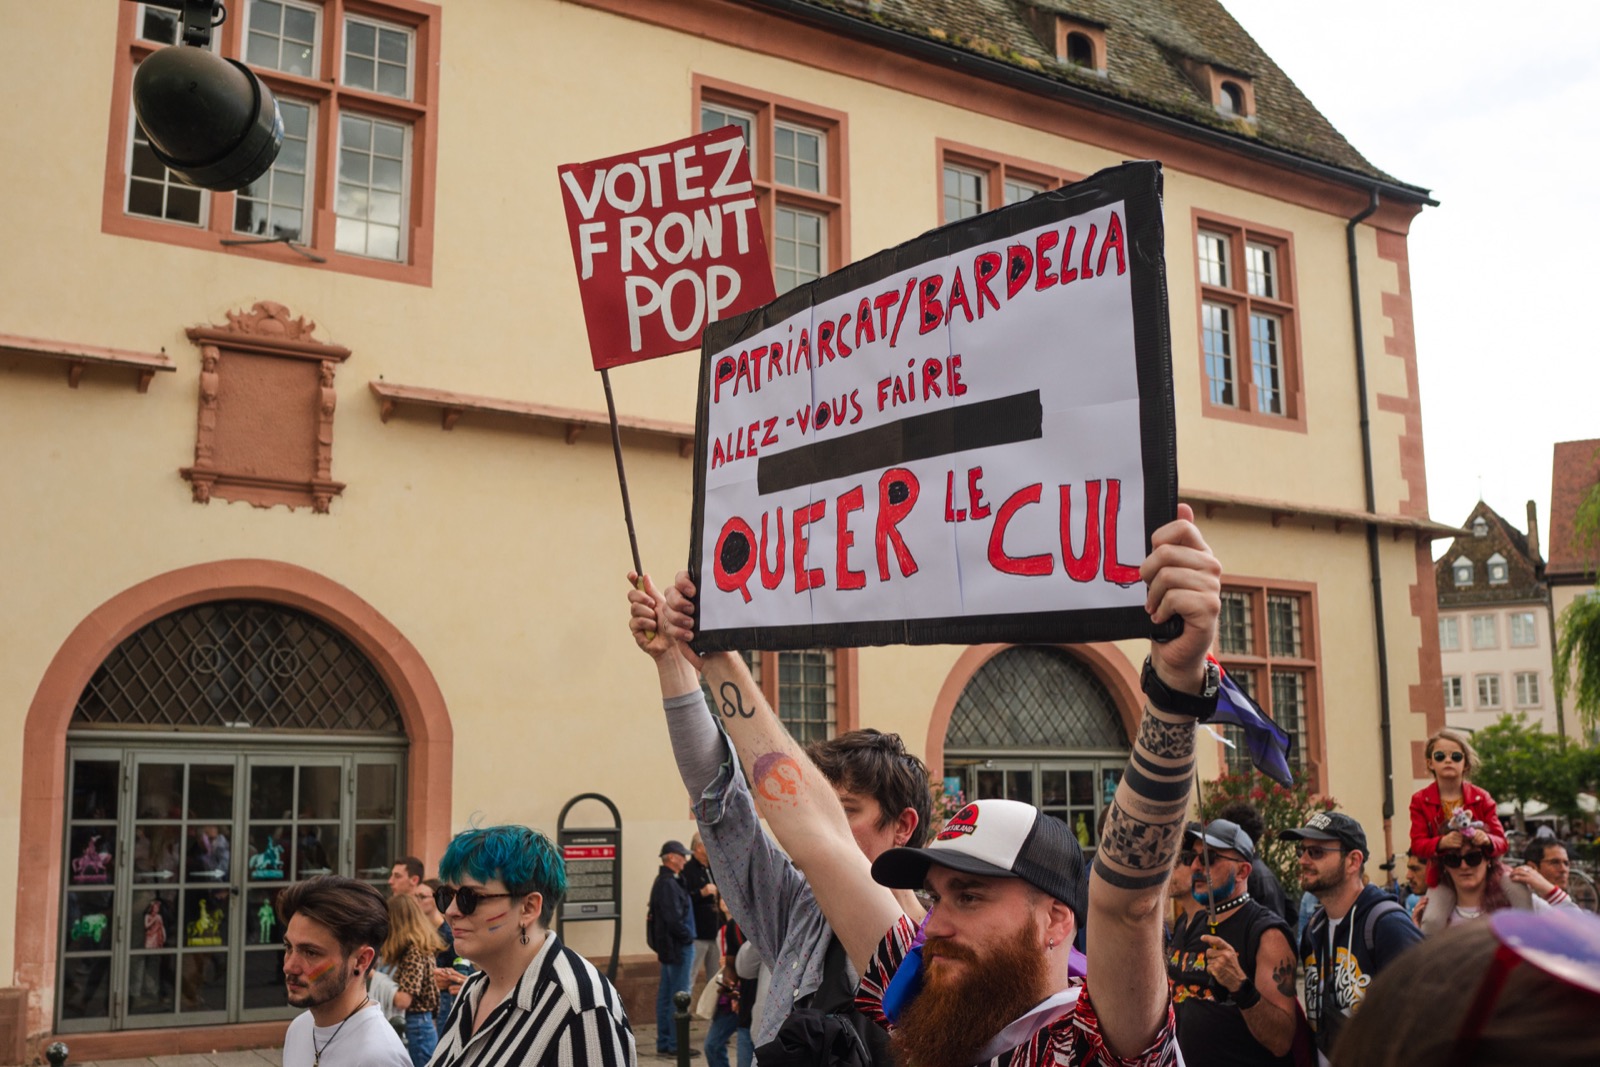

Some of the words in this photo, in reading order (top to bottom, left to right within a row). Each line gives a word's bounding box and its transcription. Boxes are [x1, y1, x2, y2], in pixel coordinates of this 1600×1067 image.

[561, 136, 752, 220] VOTEZ
[579, 198, 756, 280] FRONT
[625, 265, 741, 352] POP
[713, 467, 920, 604] QUEER
[944, 466, 991, 522] LE
[987, 478, 1142, 586] CUL
